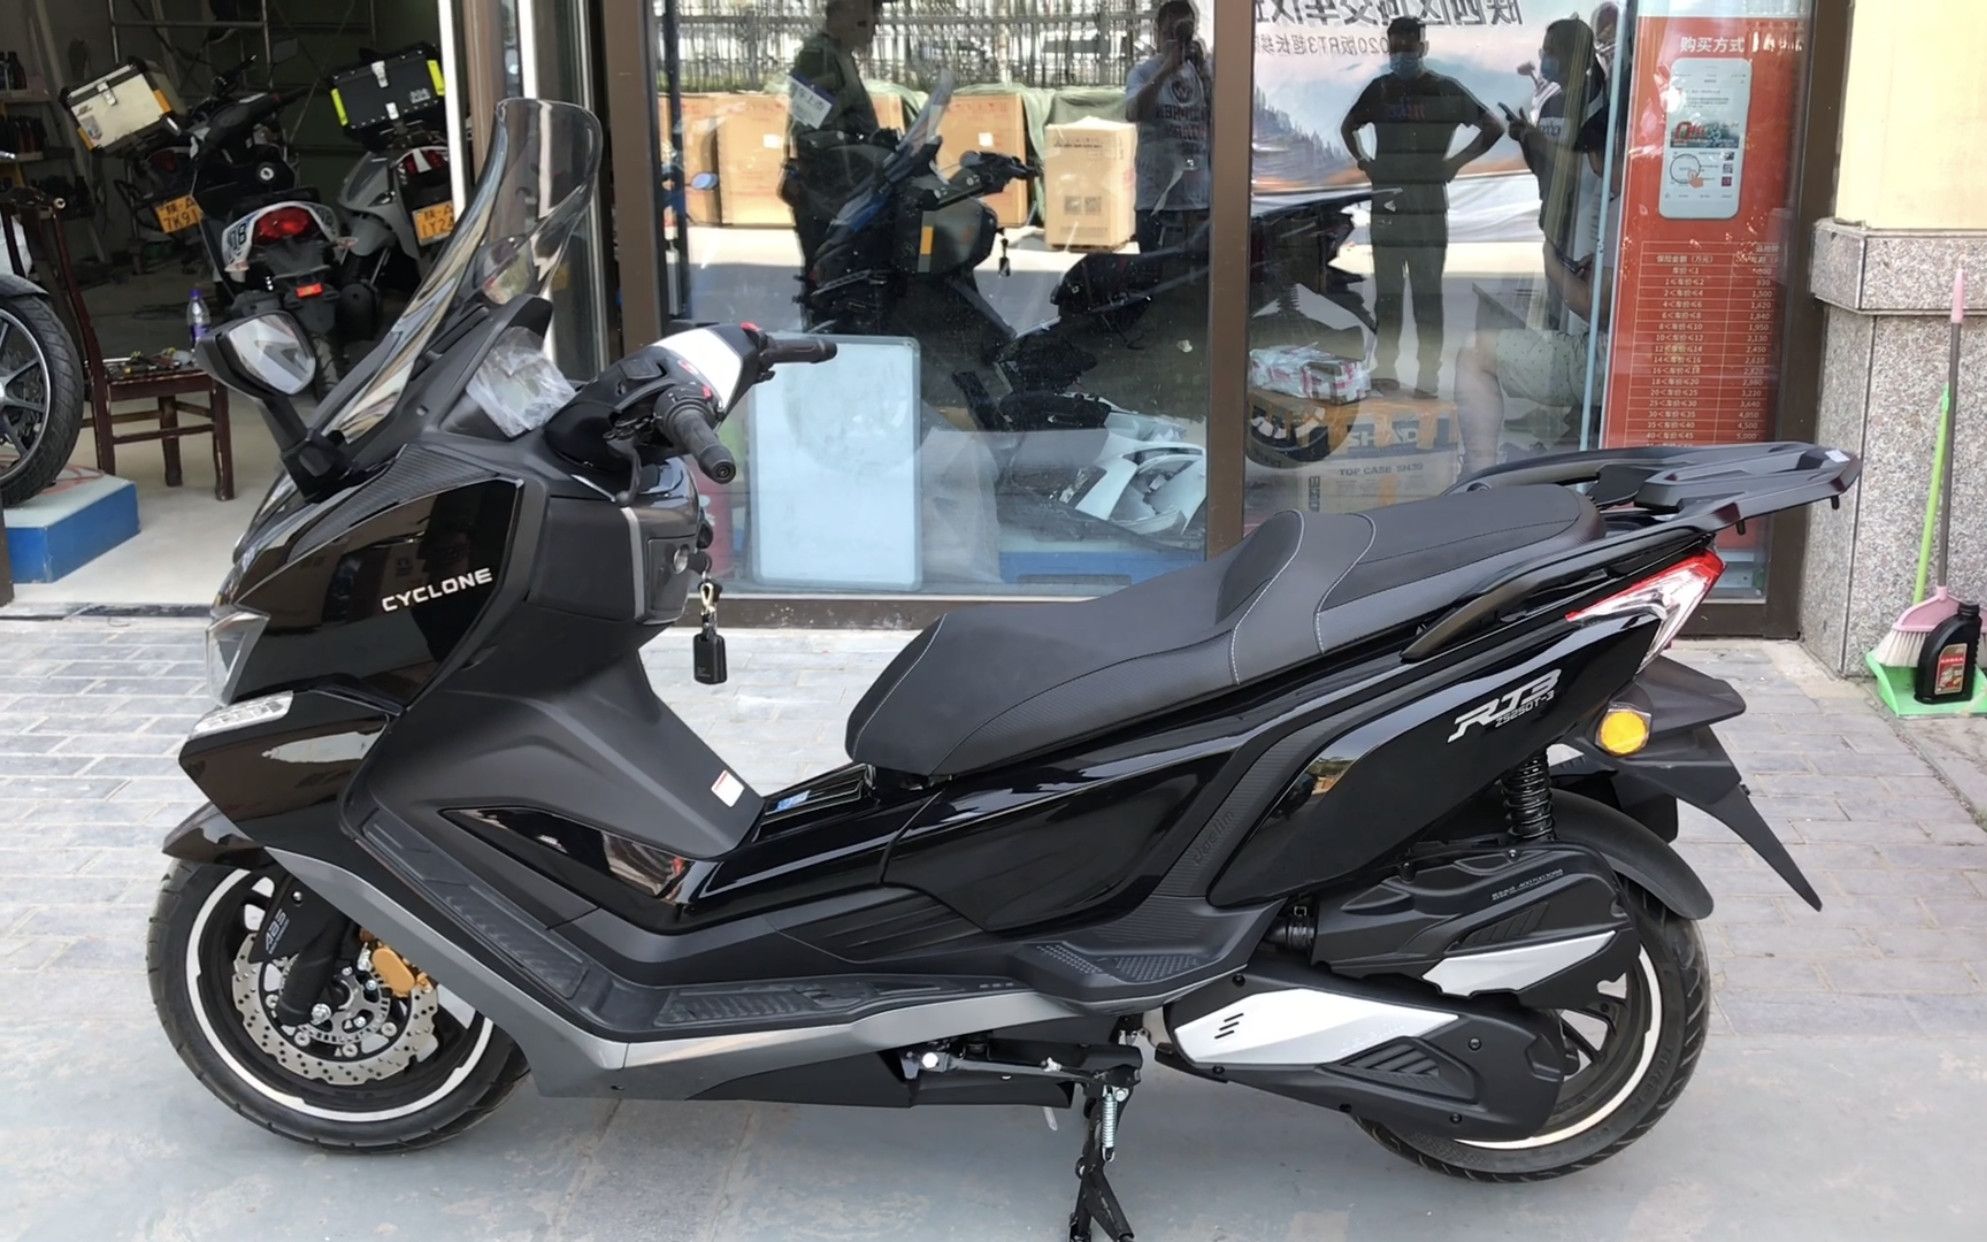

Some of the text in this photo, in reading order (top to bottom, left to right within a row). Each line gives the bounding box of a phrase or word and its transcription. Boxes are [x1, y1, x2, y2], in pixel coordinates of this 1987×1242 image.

[1680, 36, 1746, 53] 购买方式
[1339, 468, 1361, 476] TOP
[1364, 466, 1392, 474] CASE
[382, 567, 493, 612] CYCLONE
[1447, 668, 1562, 743] RT3
[1494, 689, 1555, 728] ZS250T-3
[265, 908, 287, 951] ABS
